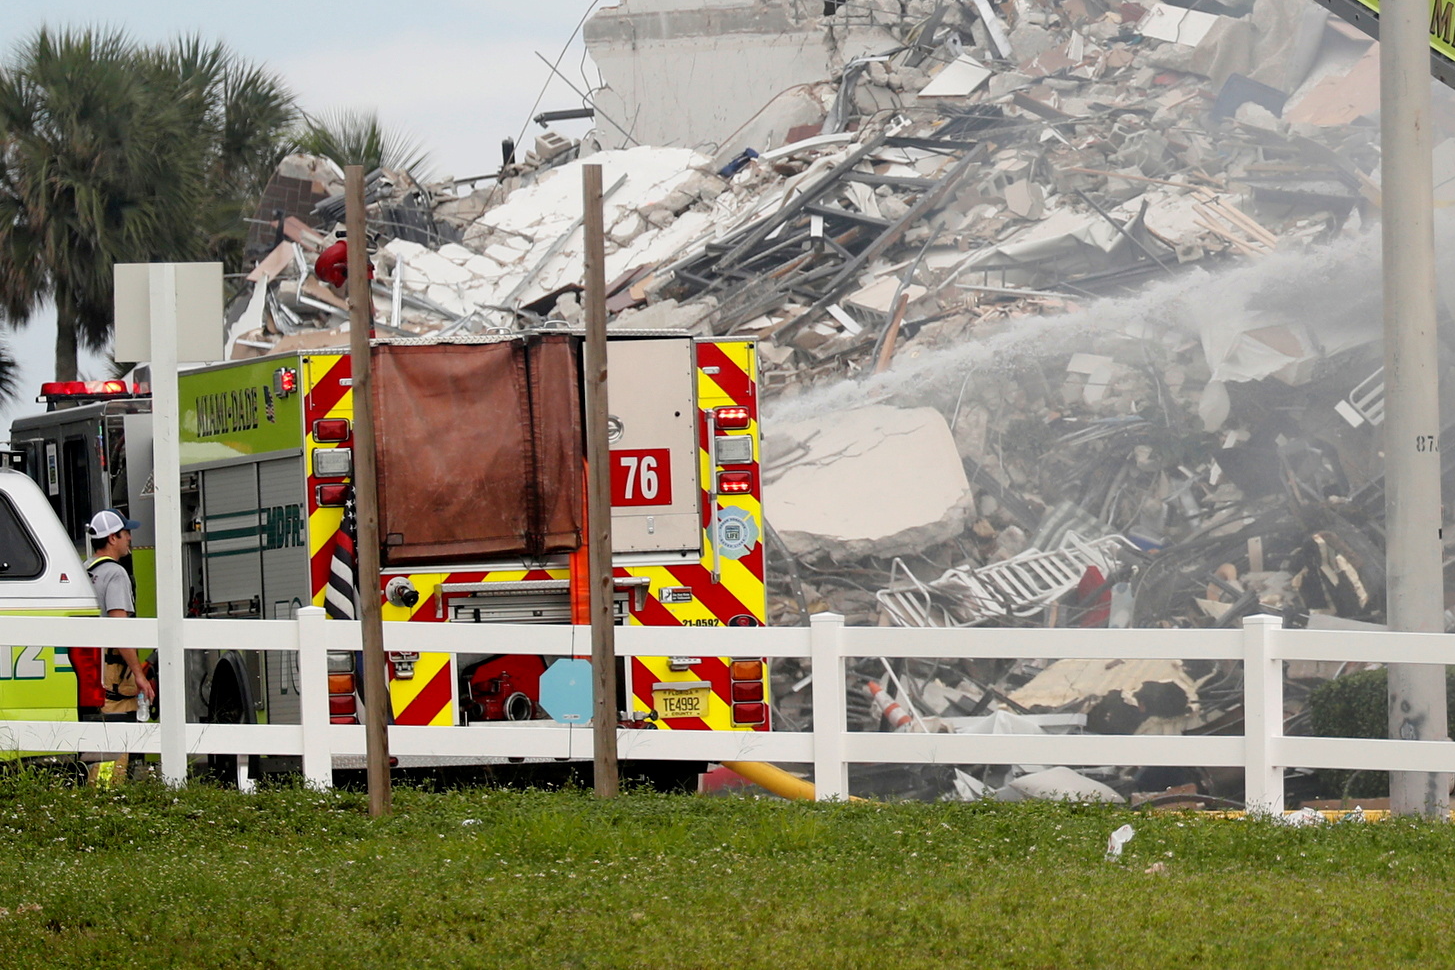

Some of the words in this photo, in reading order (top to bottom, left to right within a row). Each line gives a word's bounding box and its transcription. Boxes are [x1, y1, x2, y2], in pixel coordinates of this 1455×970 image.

[195, 386, 259, 438] MIAMI-DADE
[620, 455, 659, 500] 76
[266, 504, 305, 550] MDFR
[663, 697, 700, 711] TE4992
